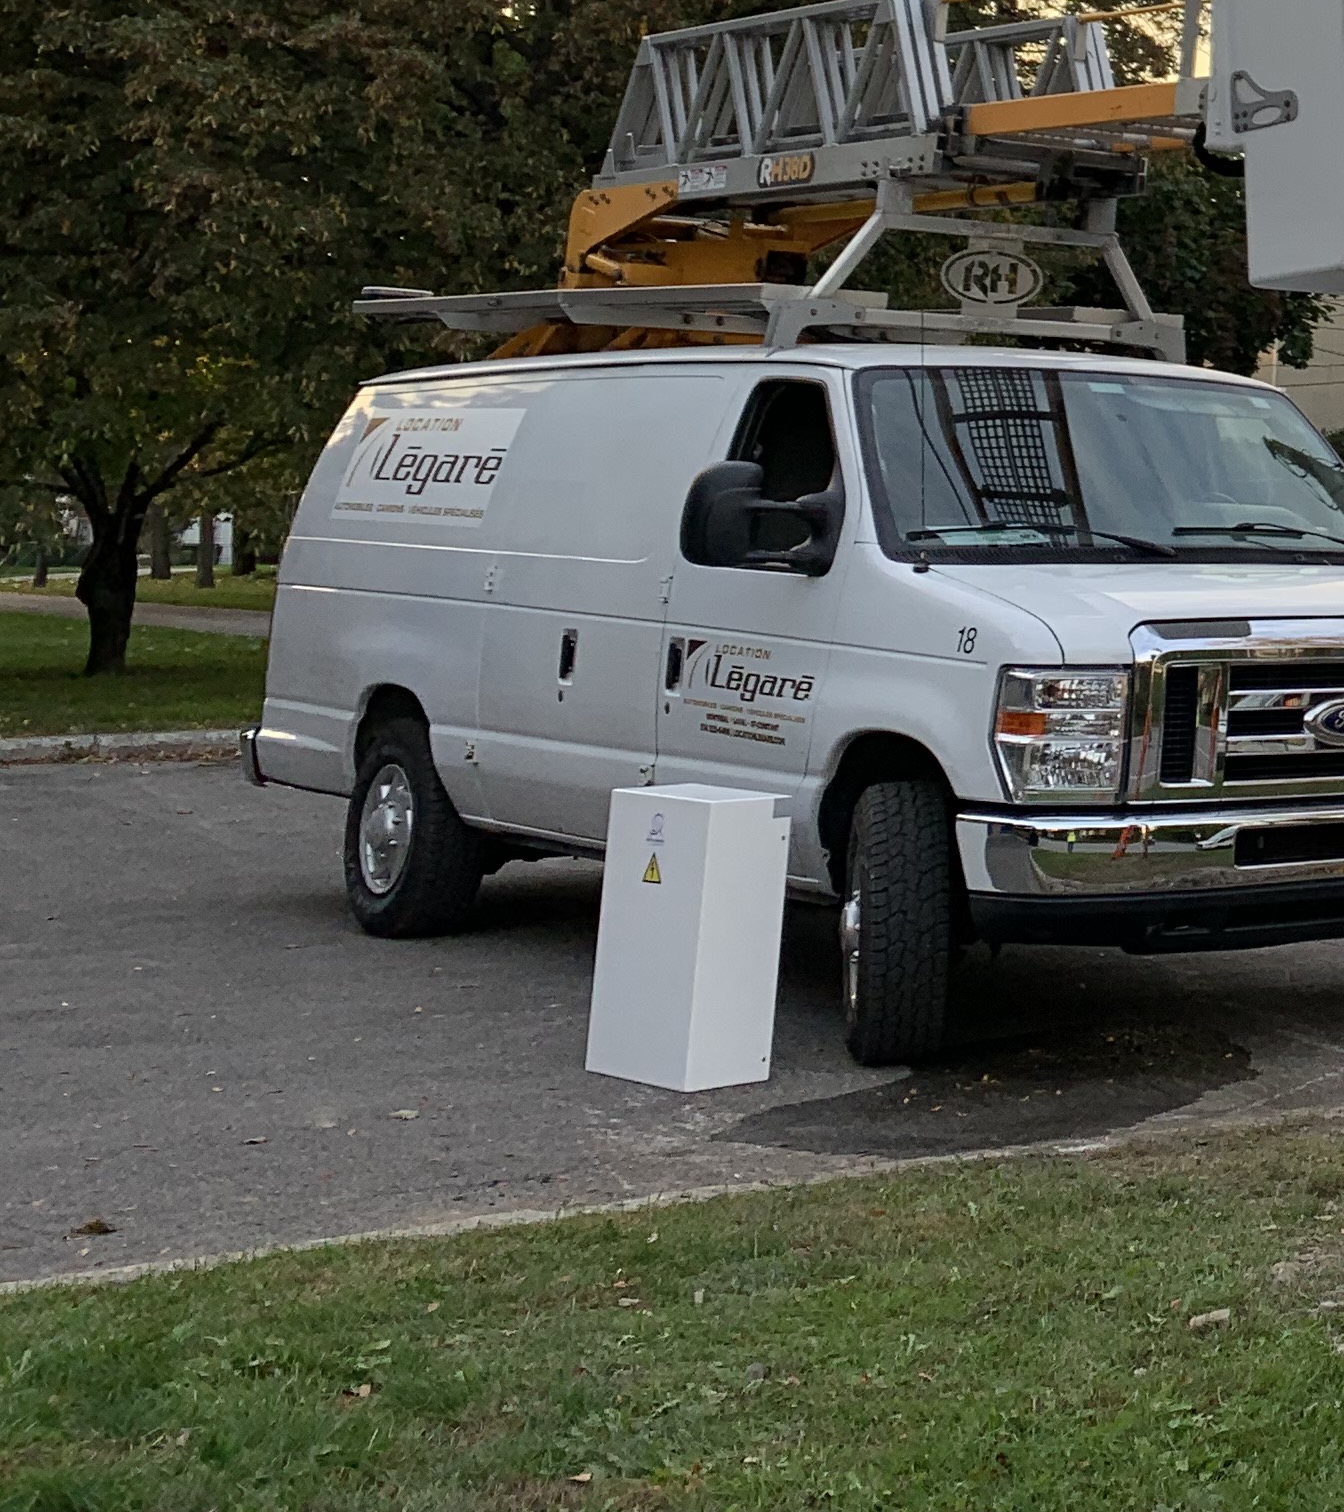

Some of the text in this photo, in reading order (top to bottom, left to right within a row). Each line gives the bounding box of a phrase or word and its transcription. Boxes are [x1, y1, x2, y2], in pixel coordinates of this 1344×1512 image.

[963, 259, 1019, 298] RH
[395, 418, 465, 432] LOCATION
[957, 626, 977, 654] 18
[715, 644, 772, 660] LOCATION
